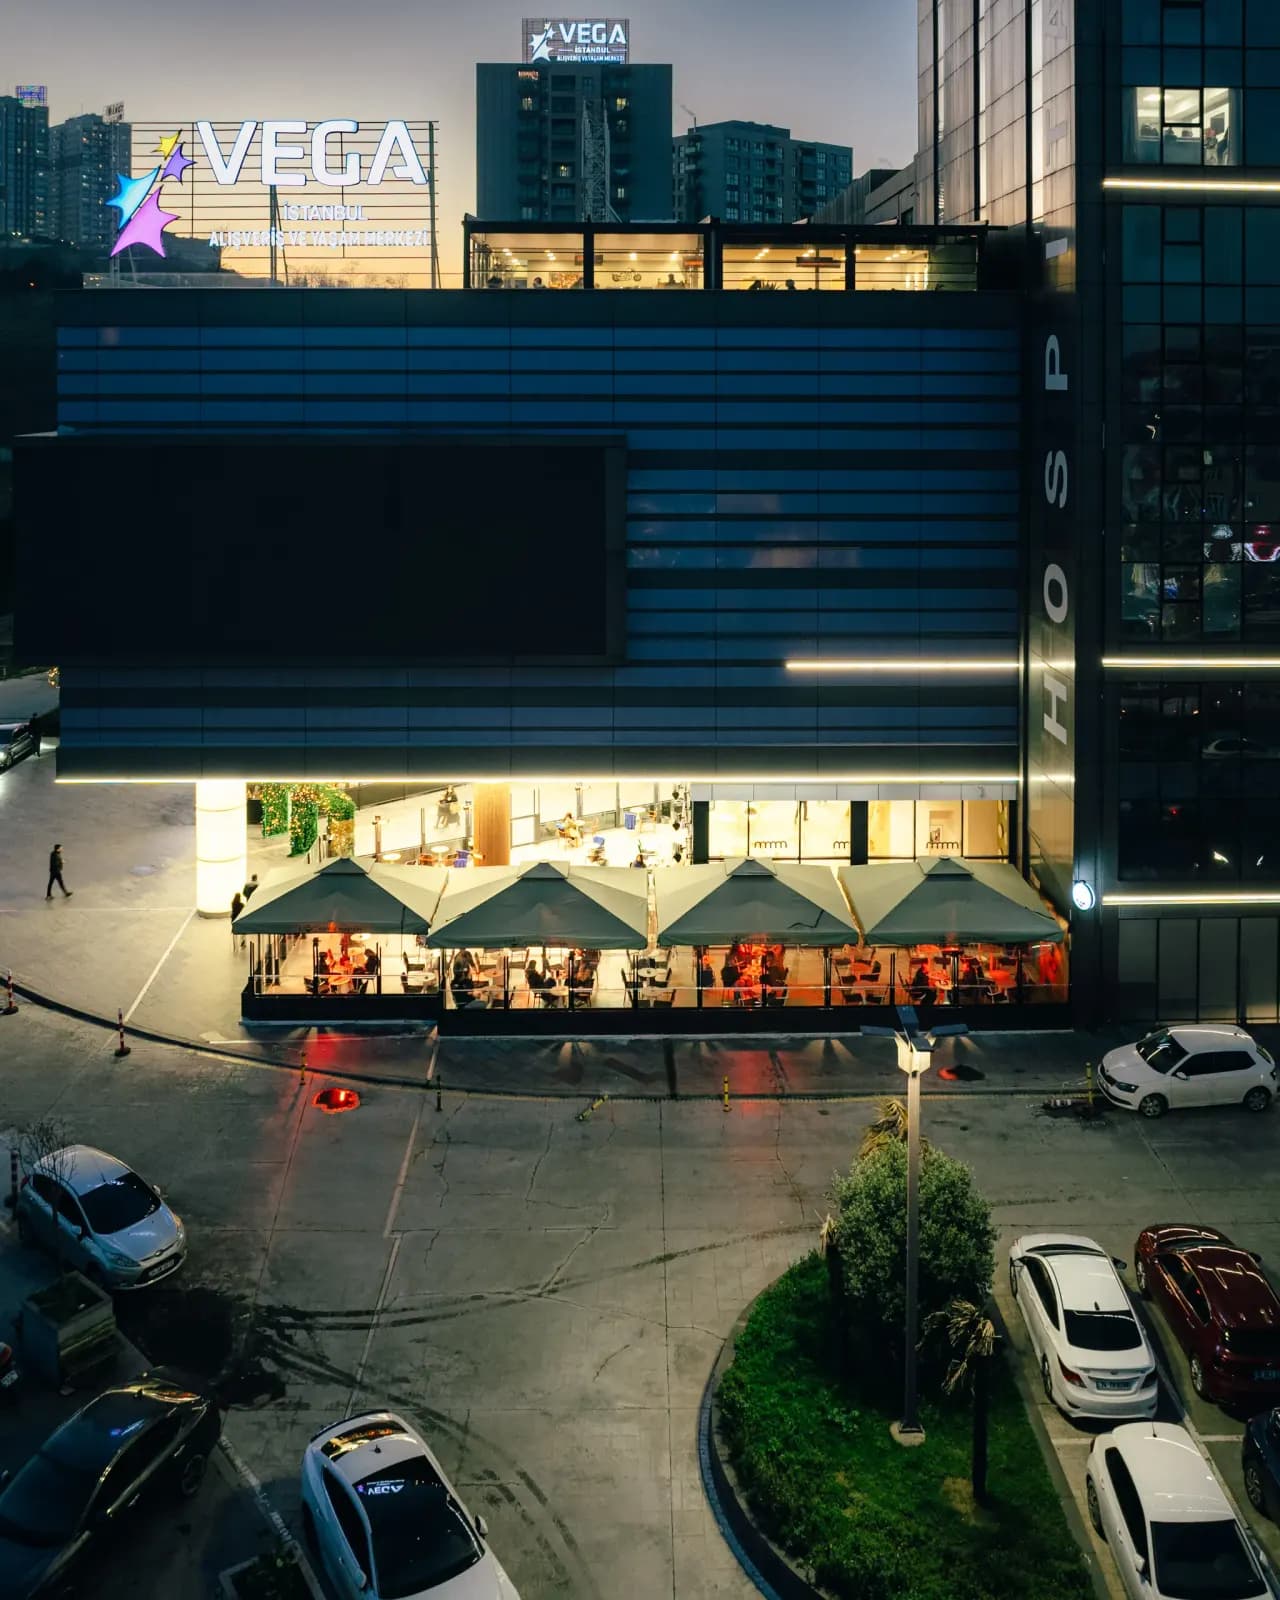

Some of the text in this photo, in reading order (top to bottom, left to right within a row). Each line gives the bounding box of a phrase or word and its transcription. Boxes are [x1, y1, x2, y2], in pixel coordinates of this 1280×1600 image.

[558, 23, 627, 44] VEGA
[196, 119, 428, 187] VEGA
[283, 201, 368, 221] İSTANBUL
[209, 226, 428, 250] ALIŞVERİŞ VE YAŞAM MERKEZİ
